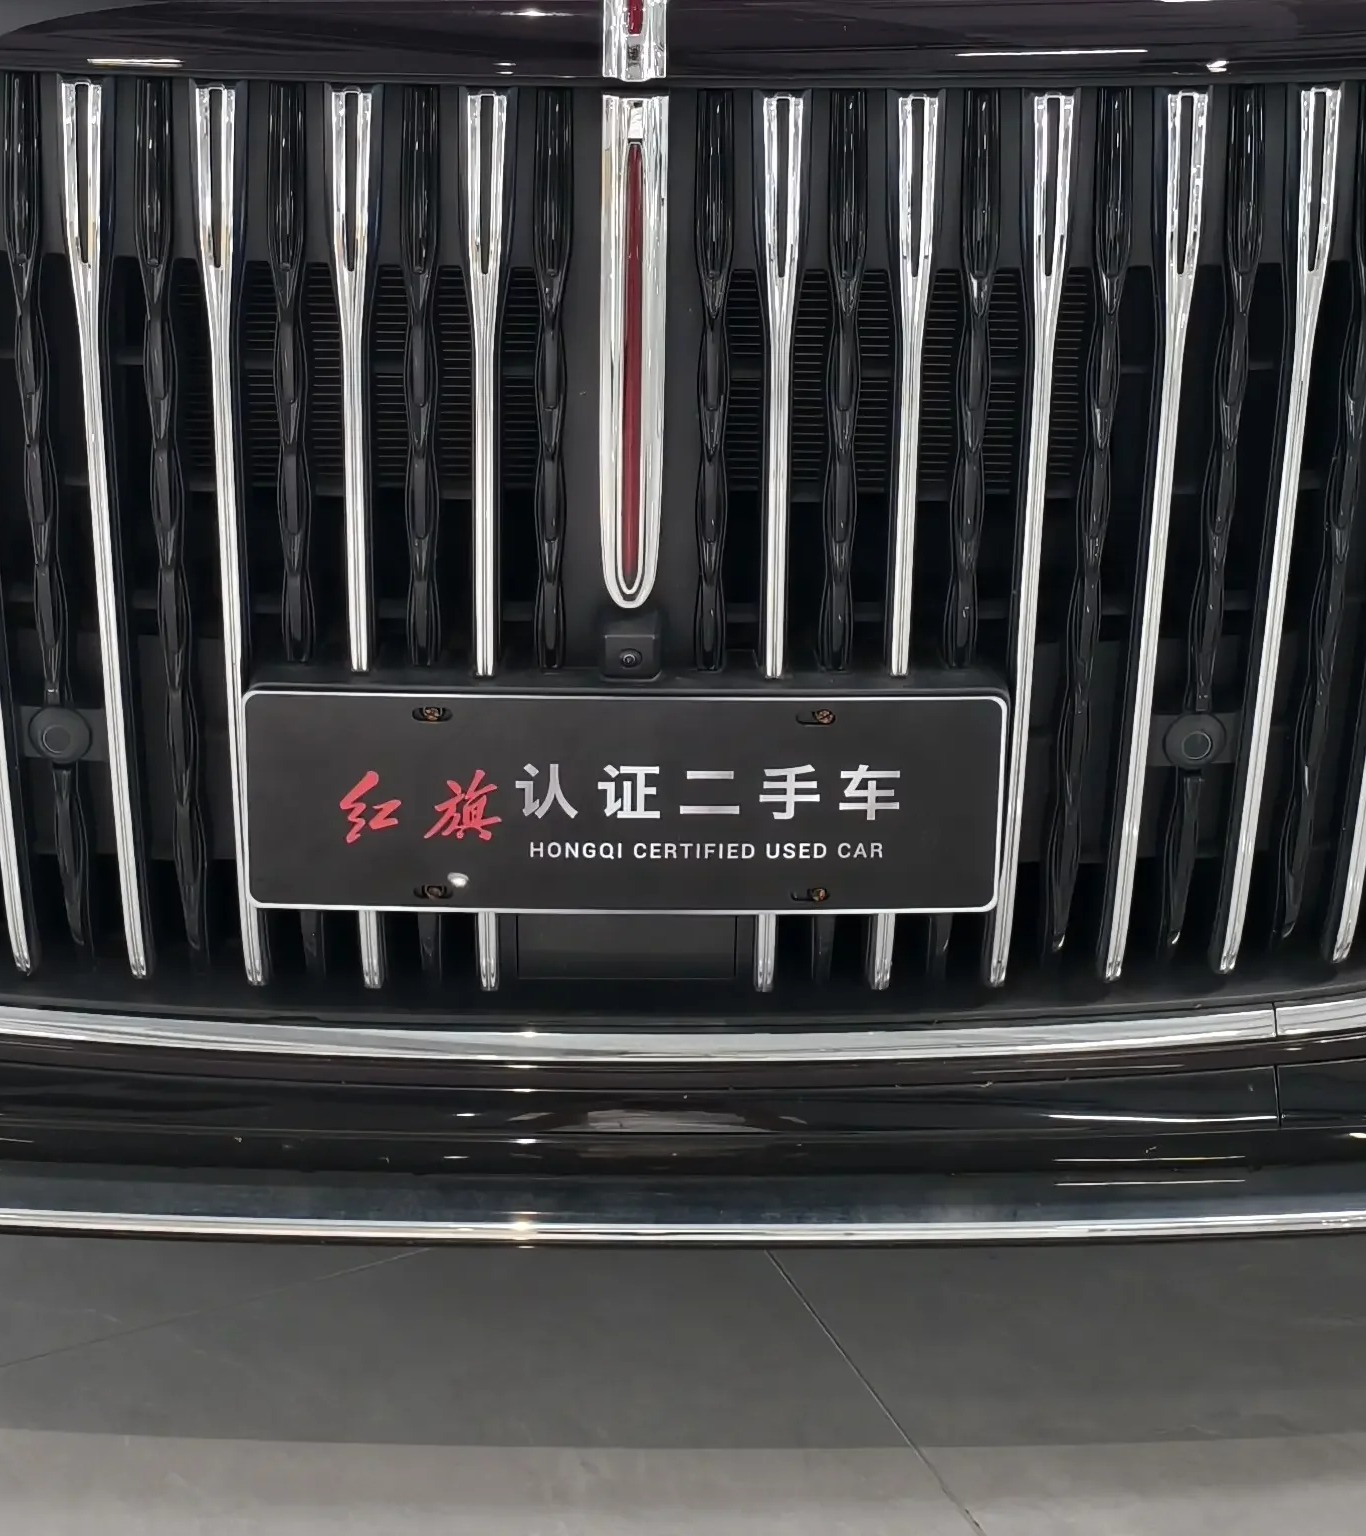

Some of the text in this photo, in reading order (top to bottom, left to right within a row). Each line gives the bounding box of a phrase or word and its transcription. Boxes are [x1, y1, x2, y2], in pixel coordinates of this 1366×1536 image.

[529, 842, 884, 860] HONGQI CERTIFIED USED CAR
